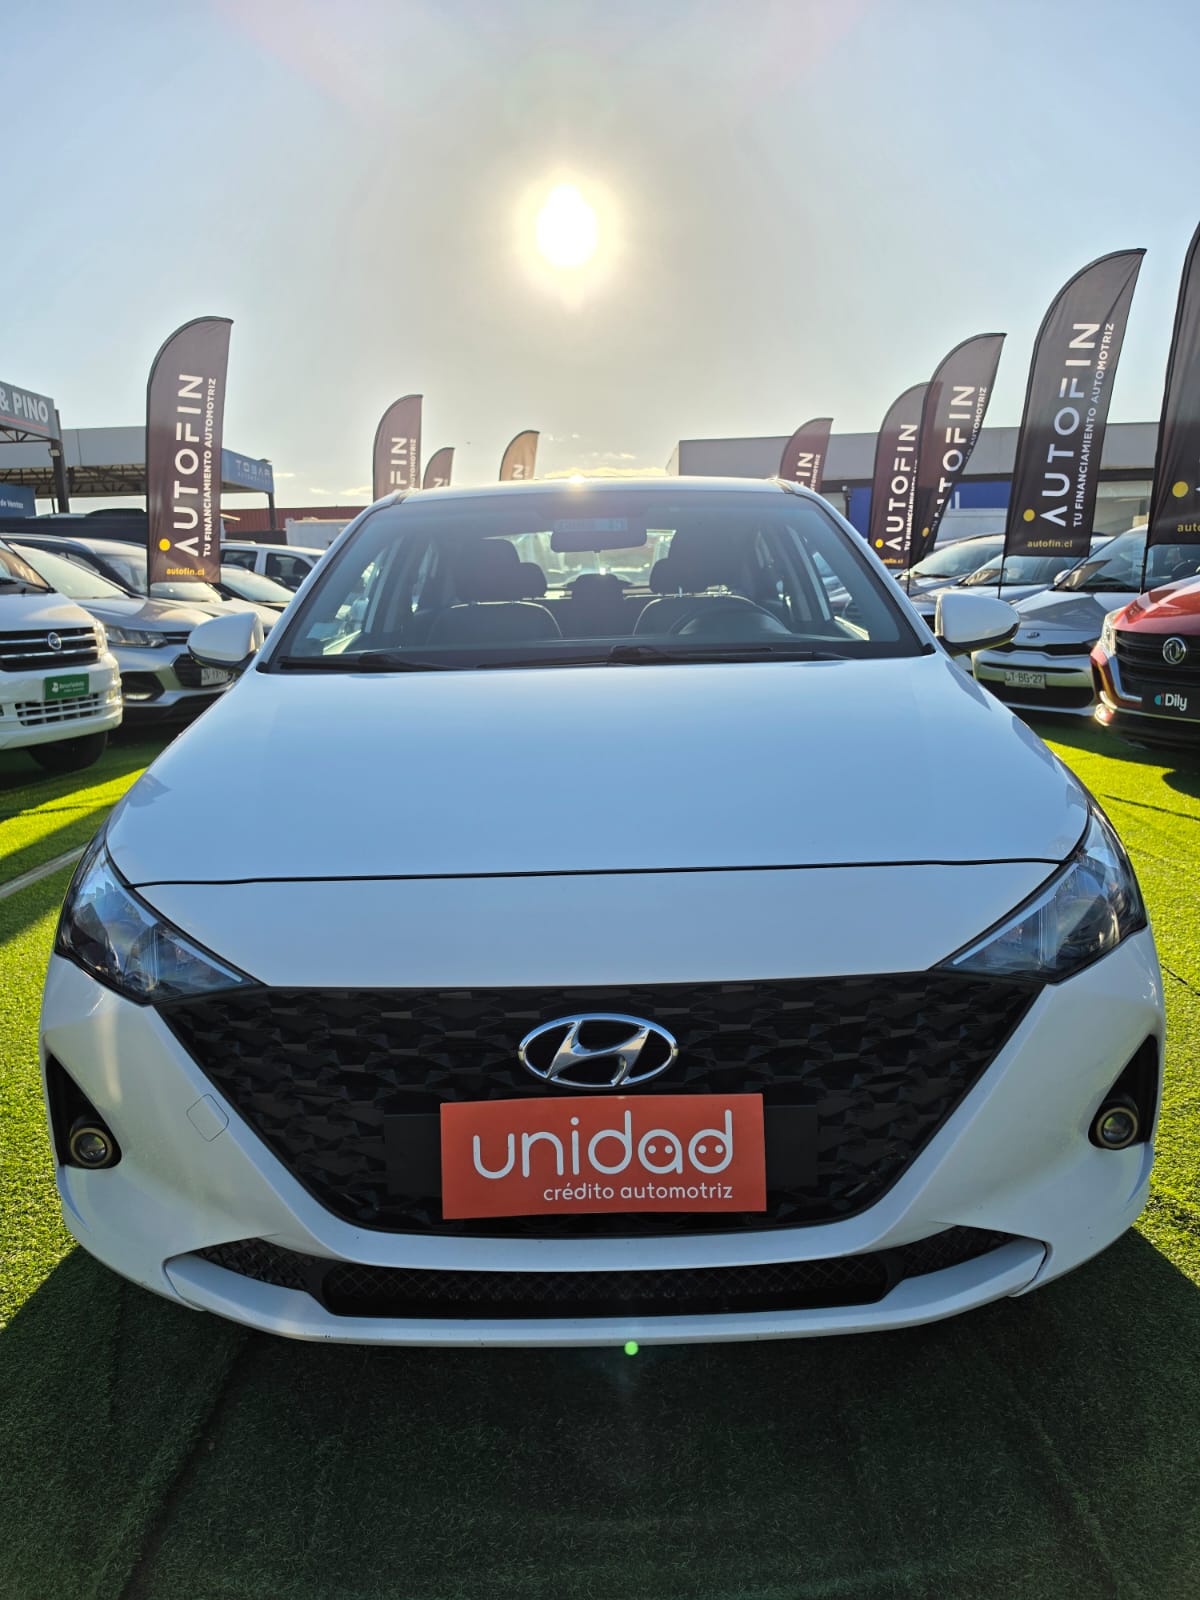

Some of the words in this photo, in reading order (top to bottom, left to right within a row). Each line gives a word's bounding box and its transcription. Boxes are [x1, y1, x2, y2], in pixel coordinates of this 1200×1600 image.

[1091, 322, 1115, 404] AUTOMOTRIZ
[12, 391, 49, 423] PINO
[203, 377, 217, 448] AUTOMOTRIZ
[1040, 323, 1100, 528] AUTOFIN
[174, 373, 203, 557] AUTOFIN
[885, 424, 918, 551] AUTOFIN
[1074, 407, 1097, 510] FINANCIAMIENTO
[203, 450, 213, 541] FINANCIAMIENTO
[1072, 512, 1083, 528] TU
[166, 566, 205, 577] autofin.cl
[203, 543, 211, 557] TU
[1027, 540, 1073, 549] autofin.cl
[1165, 692, 1188, 711] Dily
[473, 1109, 733, 1179] unidad
[543, 1182, 614, 1201] crédito
[620, 1181, 733, 1200] automotriz
